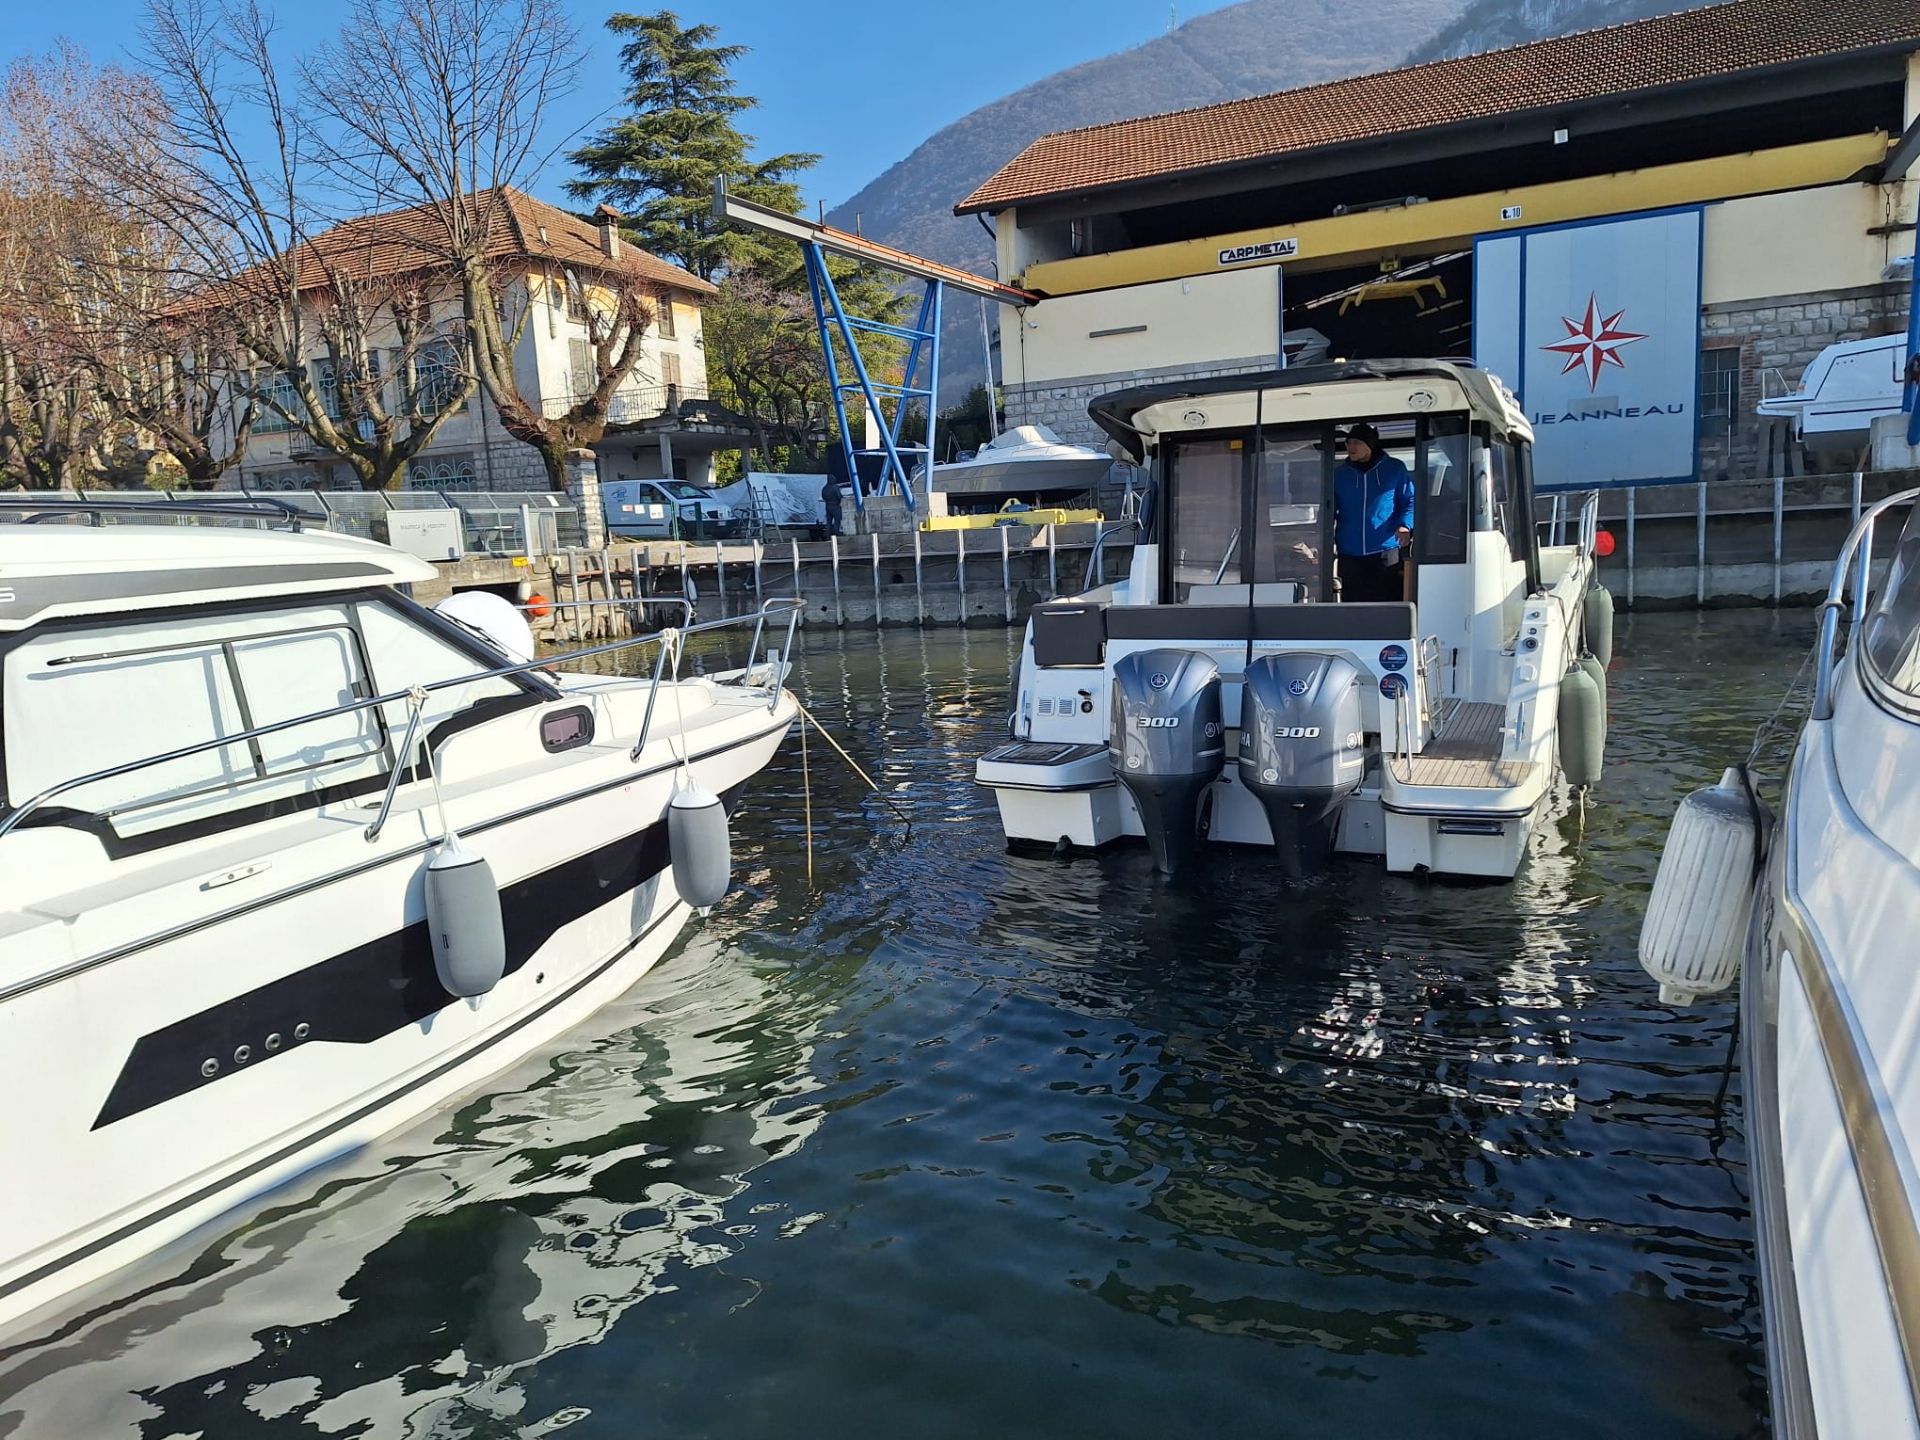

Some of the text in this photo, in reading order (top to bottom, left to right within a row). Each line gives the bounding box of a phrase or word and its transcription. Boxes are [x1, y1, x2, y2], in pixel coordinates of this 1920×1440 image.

[1219, 241, 1296, 264] CARPMETAL
[1531, 403, 1684, 425] JEANNEAU
[1137, 716, 1180, 728] 300
[1274, 726, 1321, 738] 300
